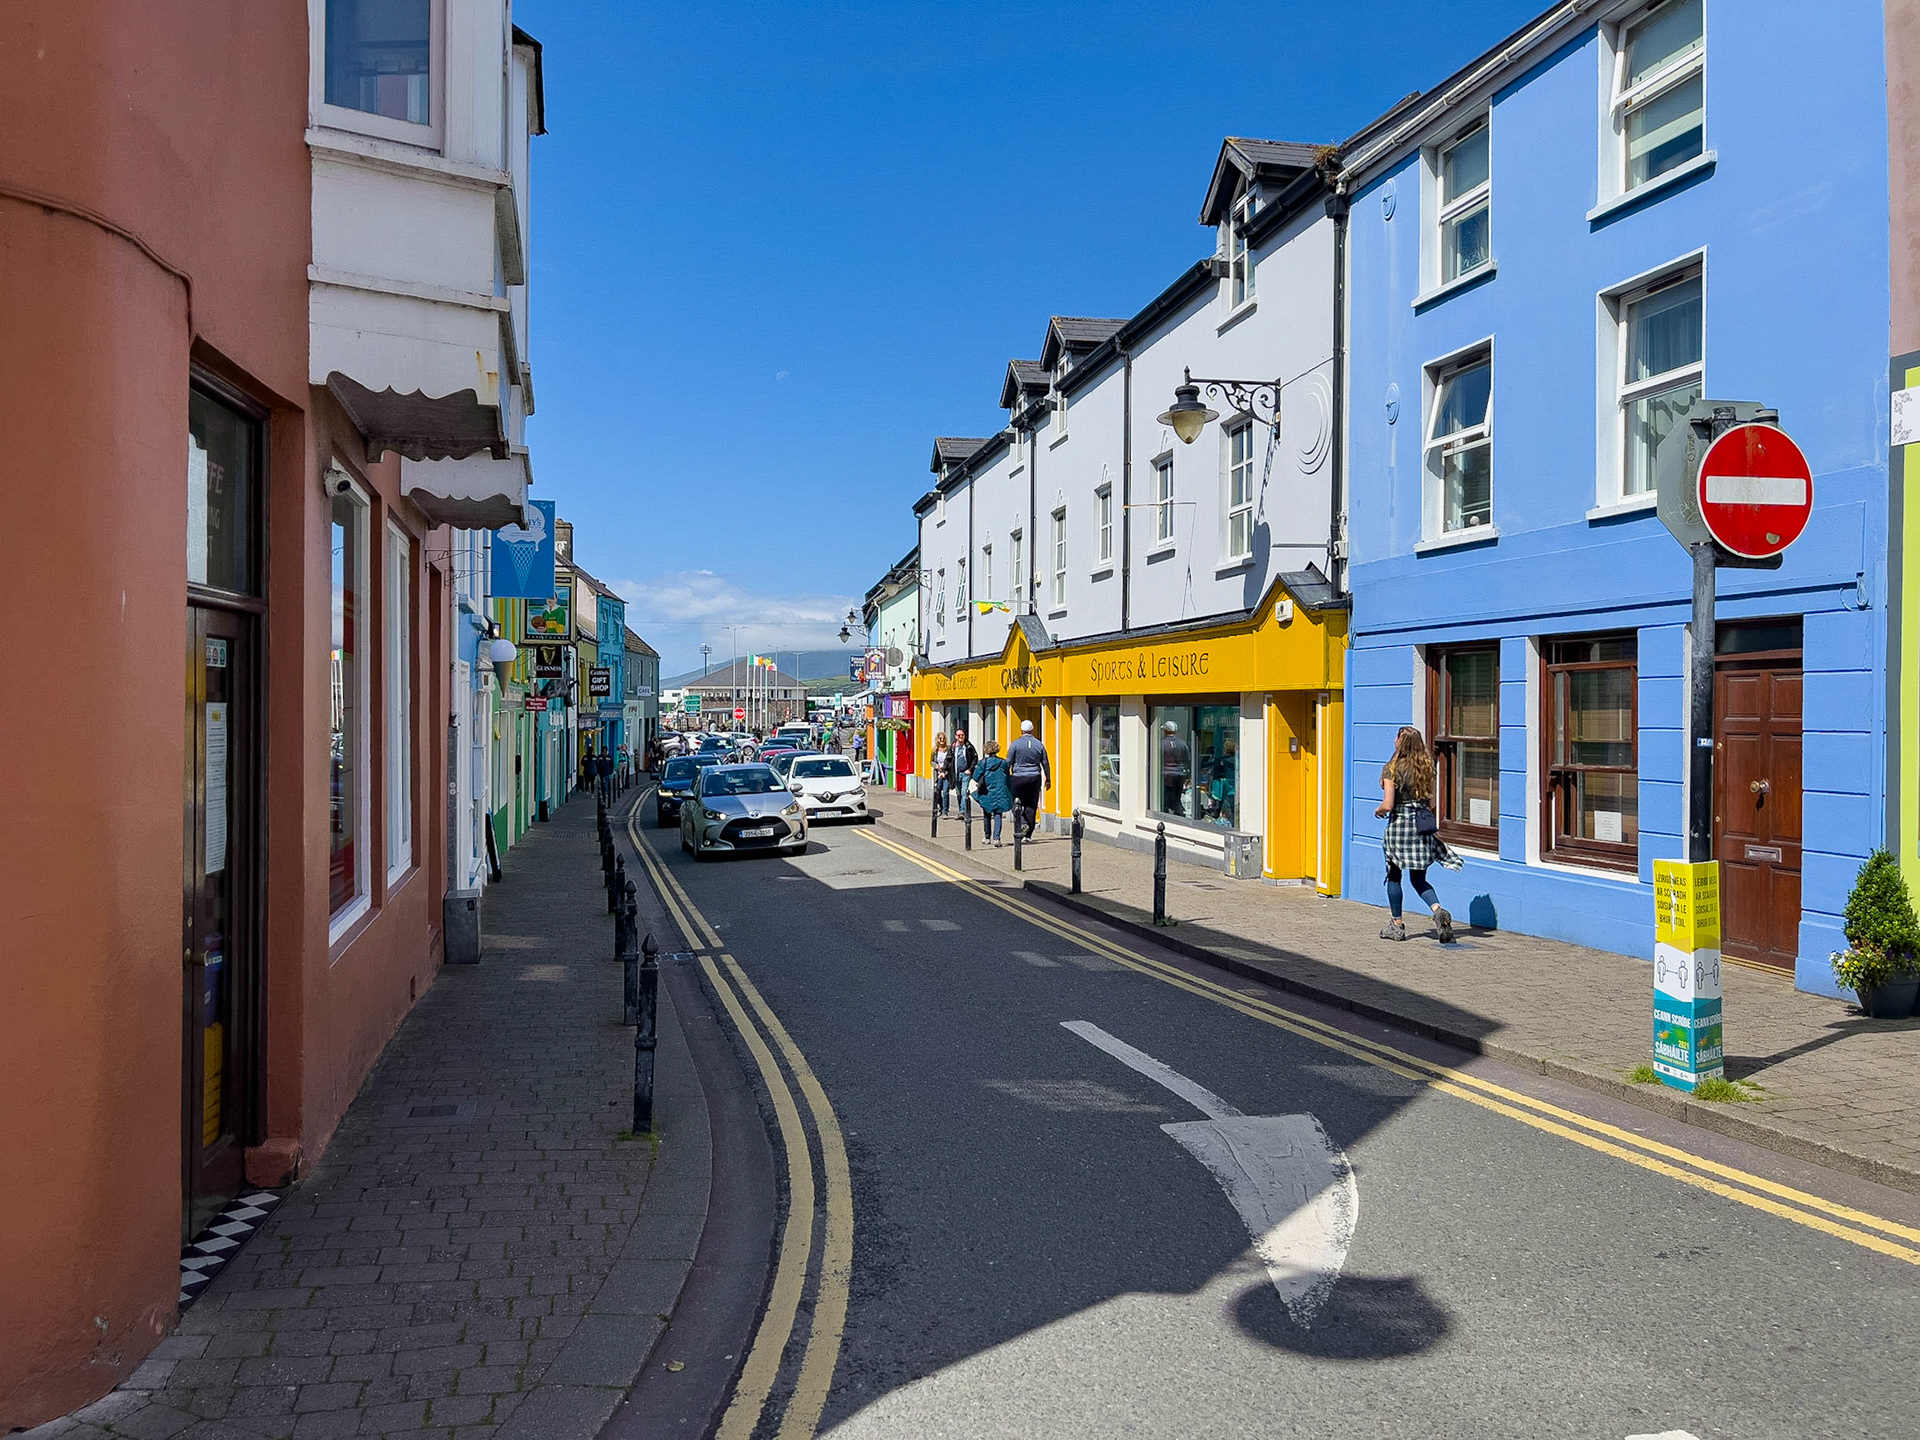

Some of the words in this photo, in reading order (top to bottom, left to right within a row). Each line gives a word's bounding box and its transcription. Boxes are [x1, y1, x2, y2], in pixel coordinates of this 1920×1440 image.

[1137, 653, 1147, 679] &
[590, 684, 609, 692] SHOP
[1653, 1008, 1672, 1025] CEANN
[1693, 1017, 1709, 1029] CEANN
[1678, 1040, 1690, 1050] 2021
